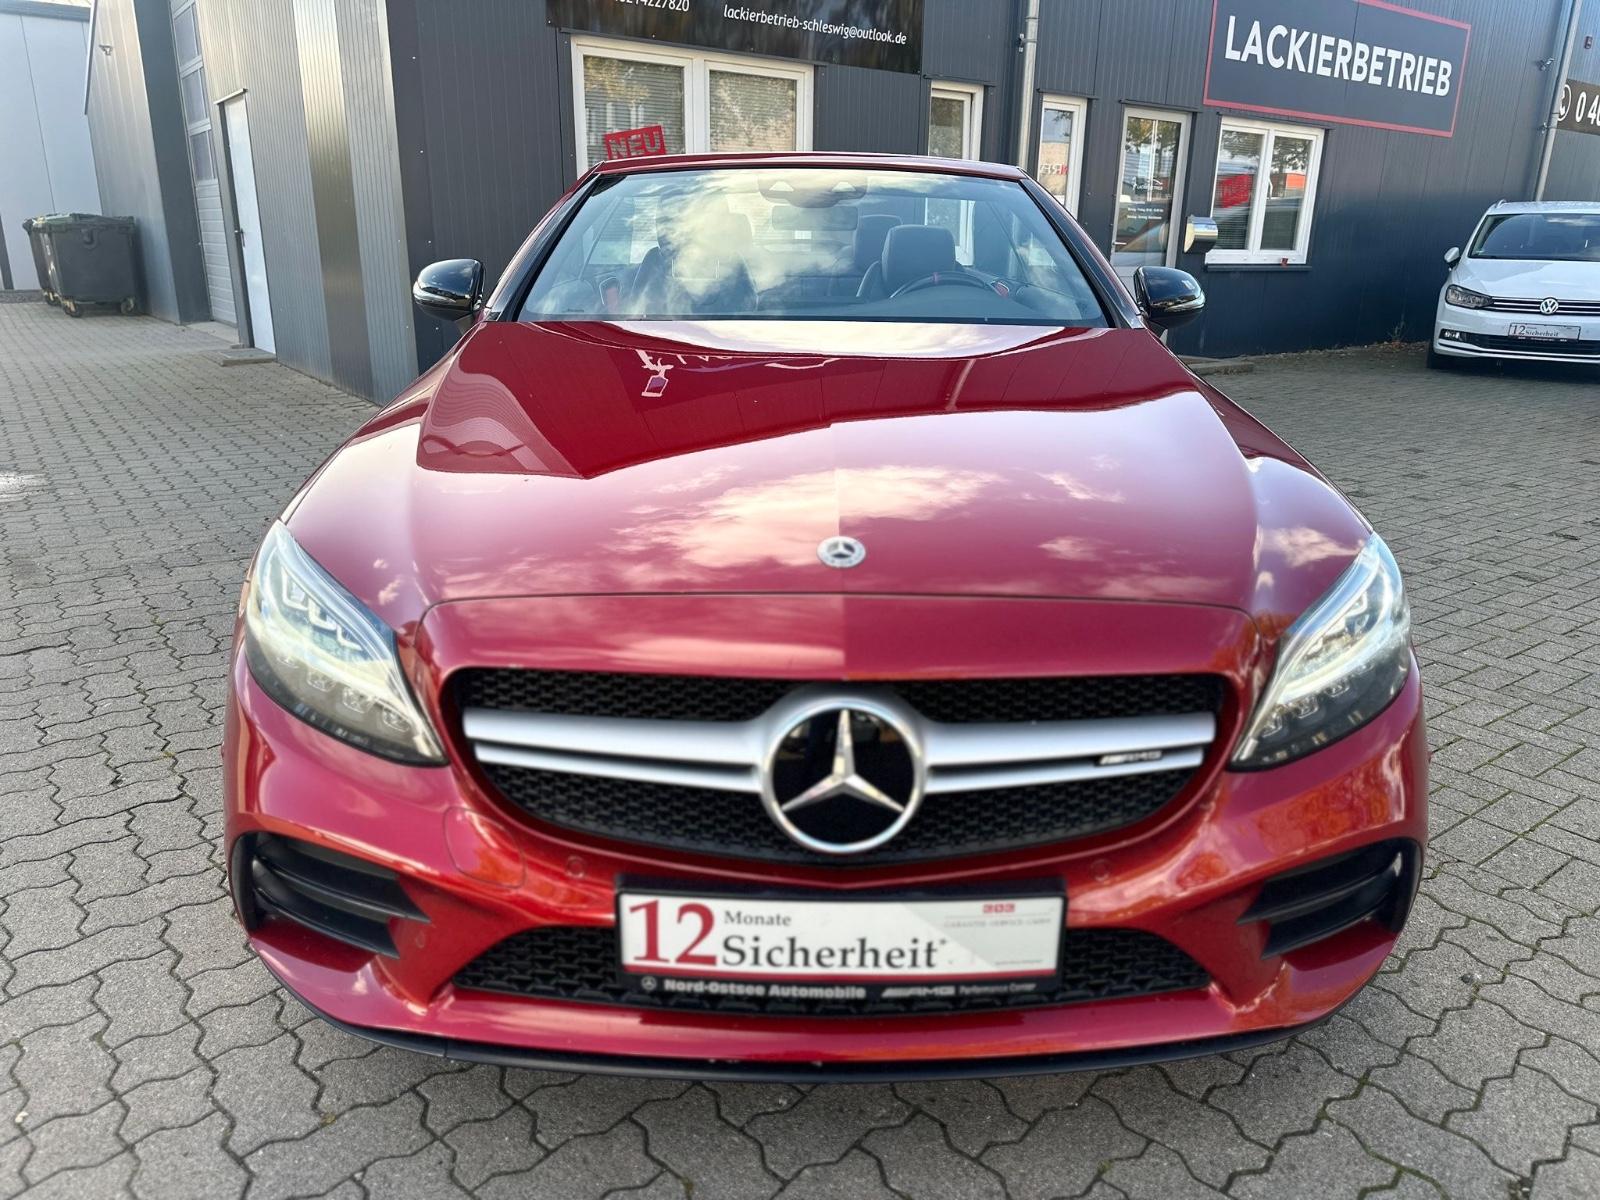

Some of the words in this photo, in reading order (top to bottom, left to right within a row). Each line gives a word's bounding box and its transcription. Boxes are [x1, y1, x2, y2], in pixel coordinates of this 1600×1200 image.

[723, 4, 907, 45] lackierbetrieb-schleswig@outlook.de
[1224, 15, 1453, 97] LACKIERBETRIEB
[609, 131, 660, 160] NEU
[1511, 324, 1526, 336] 12
[629, 899, 717, 967] 12
[724, 909, 792, 928] Monate
[663, 978, 766, 997] Nord-Ostsee
[768, 983, 867, 999] Automobile
